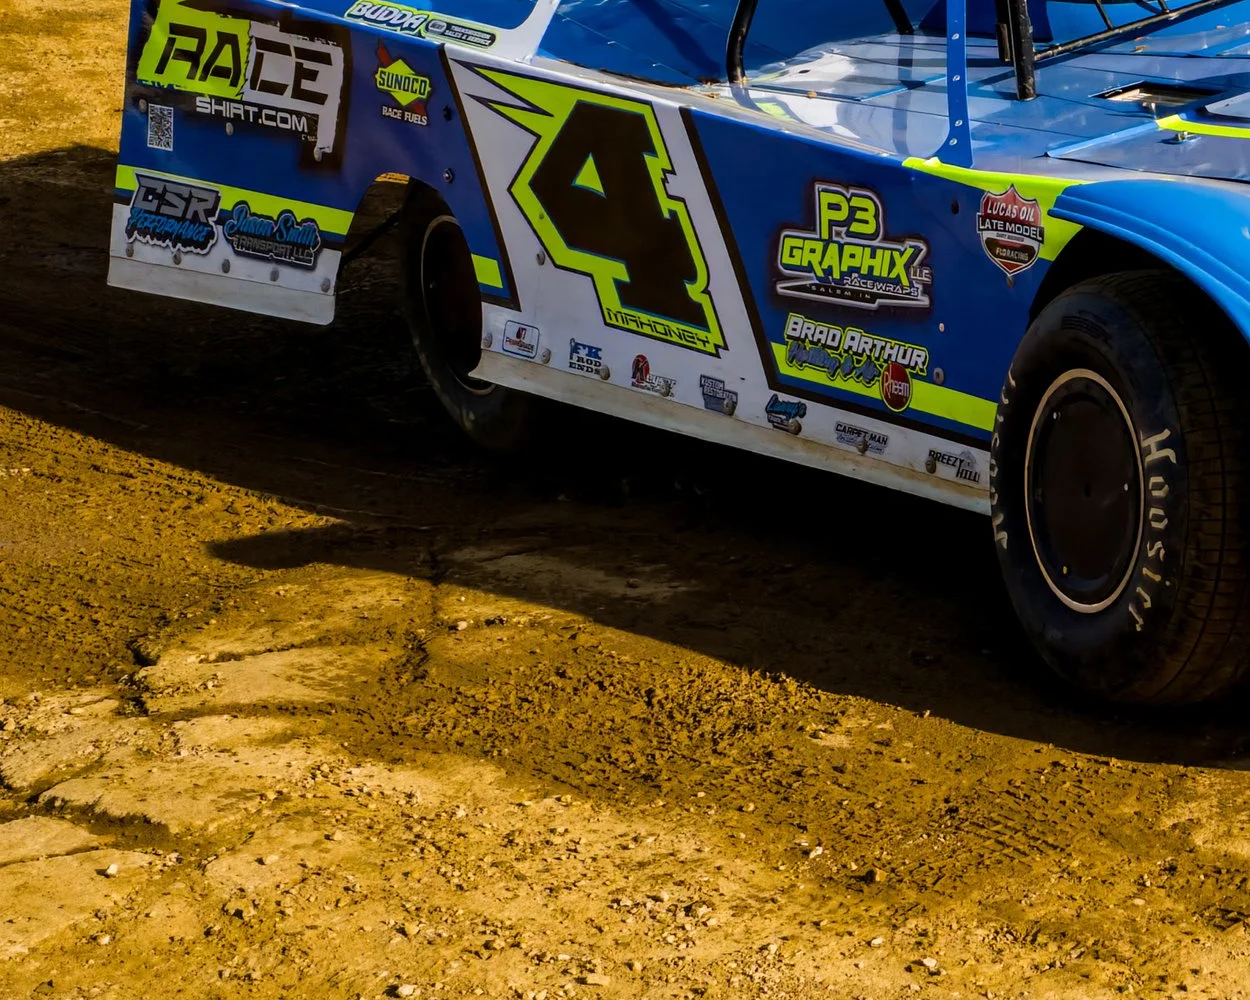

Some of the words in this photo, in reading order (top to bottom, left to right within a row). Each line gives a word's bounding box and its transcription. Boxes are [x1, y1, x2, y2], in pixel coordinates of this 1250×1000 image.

[351, 2, 427, 29] BUDDA
[154, 22, 333, 106] RACE
[378, 70, 429, 97] SUNOCO
[196, 96, 308, 132] SHIRT.COM
[382, 106, 402, 120] RACE
[404, 111, 428, 125] FUELS
[134, 173, 220, 223] CSR
[987, 200, 1019, 218] LUCAS
[1020, 206, 1035, 222] OIL
[528, 99, 712, 334] 4
[819, 191, 877, 240] P3
[979, 217, 1004, 231] LATE
[1005, 222, 1043, 241] MODEL
[781, 236, 915, 288] GRAPHIX
[843, 276, 874, 290] RACE
[876, 282, 919, 297] WRAPS
[606, 307, 710, 348] MAHONEY
[786, 315, 842, 348] BRAD
[843, 330, 928, 370] ARTHUR
[569, 361, 601, 376] ENDS
[576, 356, 602, 368] ROD
[835, 423, 868, 439] CARPET
[869, 434, 888, 446] MAN
[1129, 428, 1178, 632] Hoosier
